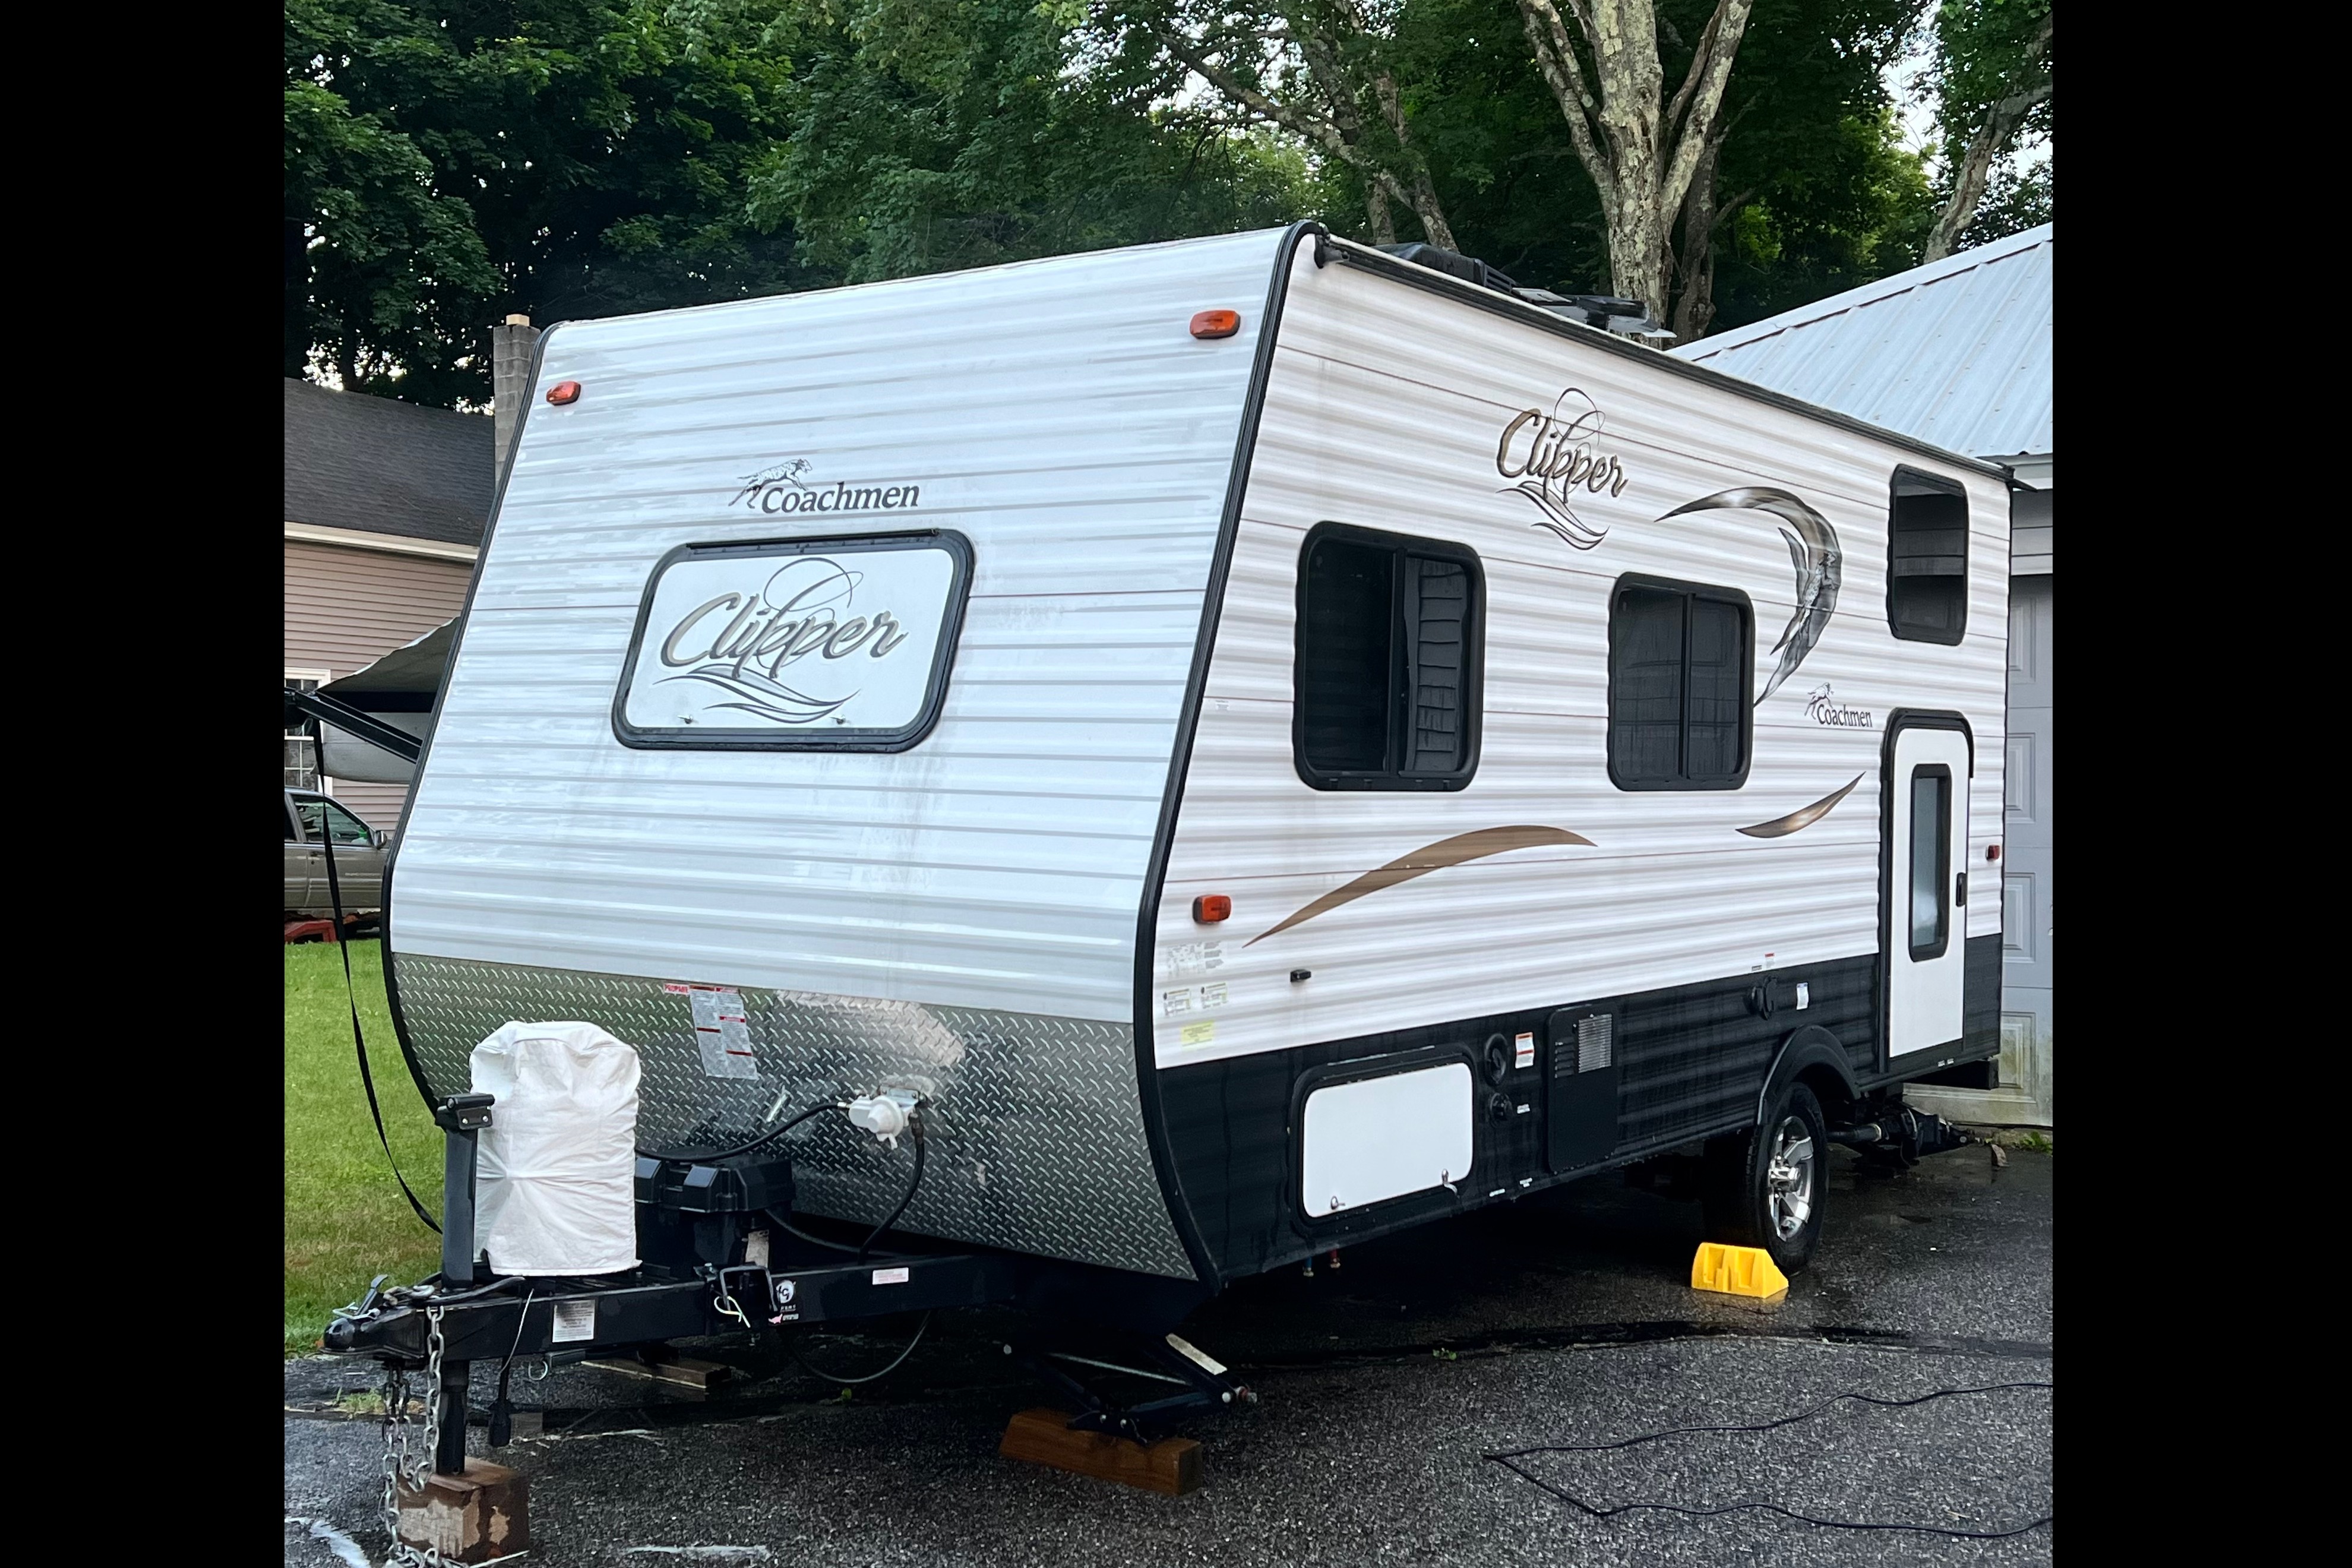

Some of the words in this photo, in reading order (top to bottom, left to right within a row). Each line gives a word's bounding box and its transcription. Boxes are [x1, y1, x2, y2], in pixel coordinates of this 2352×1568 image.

[1497, 387, 1629, 504] Clipper
[761, 482, 920, 514] Coachmen
[660, 557, 909, 679] Clipper
[1817, 704, 1873, 728] Coachmen
